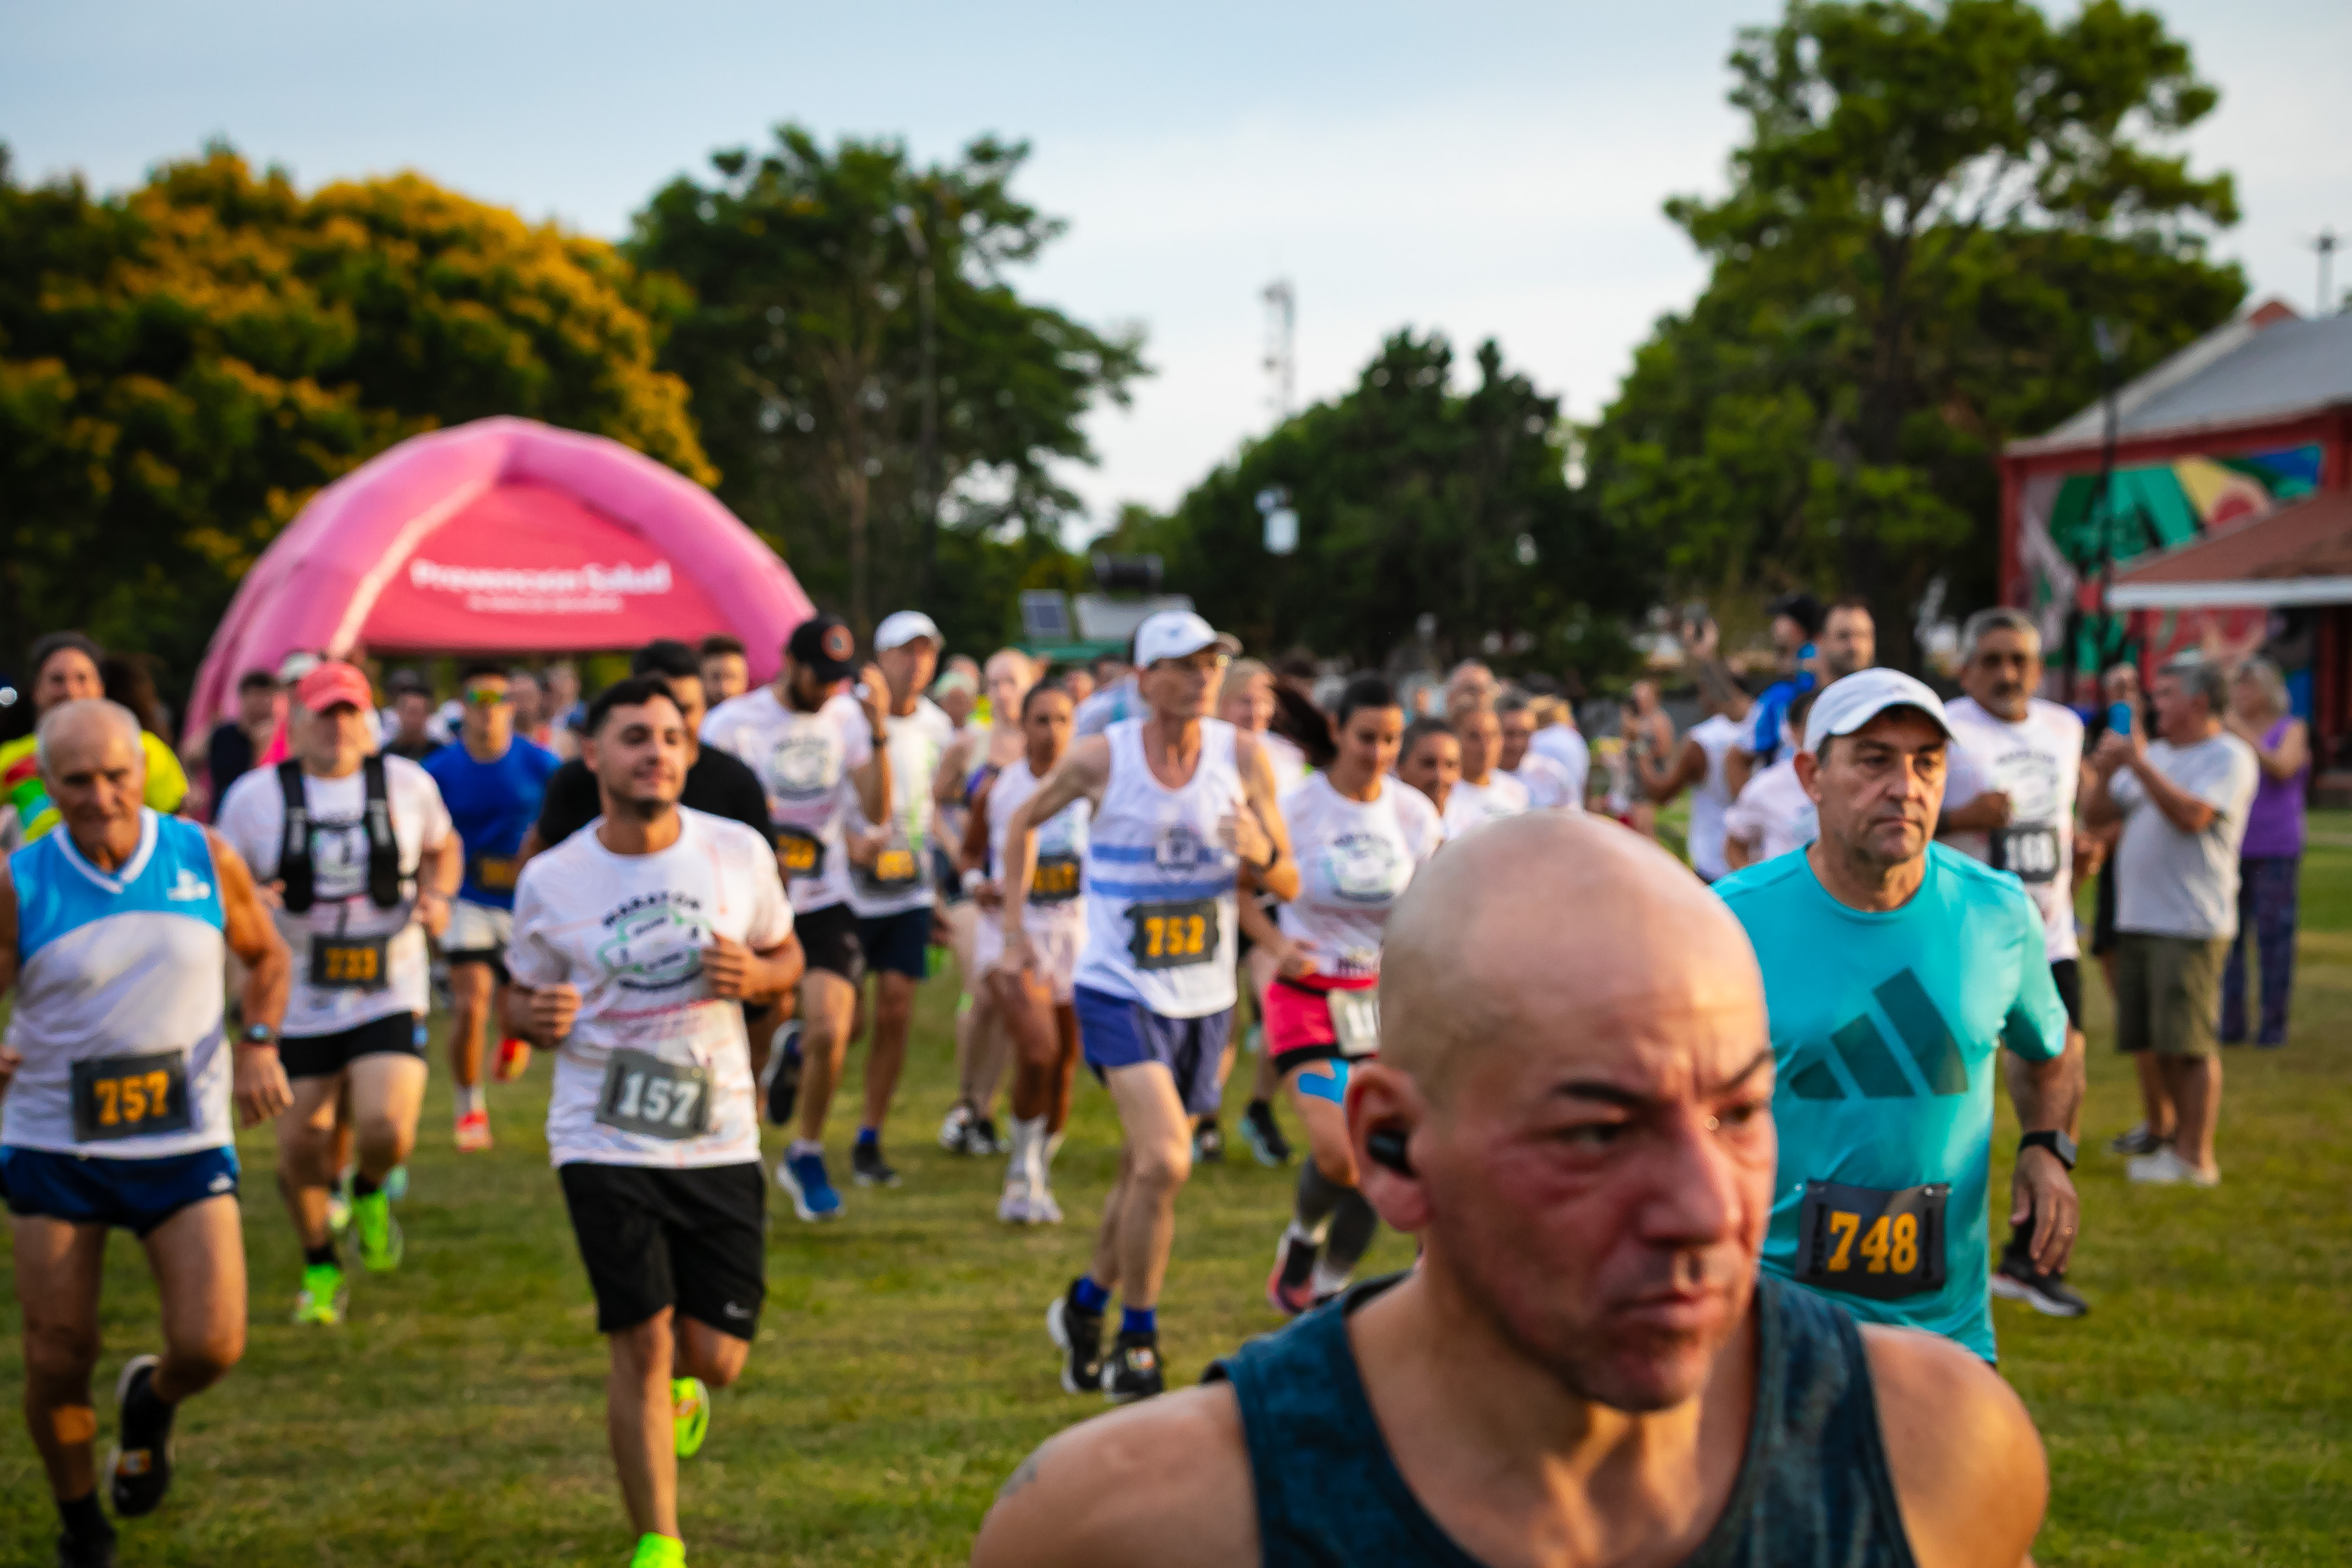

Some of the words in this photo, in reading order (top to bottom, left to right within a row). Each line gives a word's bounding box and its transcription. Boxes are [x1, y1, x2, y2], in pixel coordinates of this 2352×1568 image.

[1144, 914, 1205, 957] 752
[94, 1070, 169, 1126] 757
[617, 1072, 701, 1127] 157
[1828, 1211, 1918, 1275] 748
